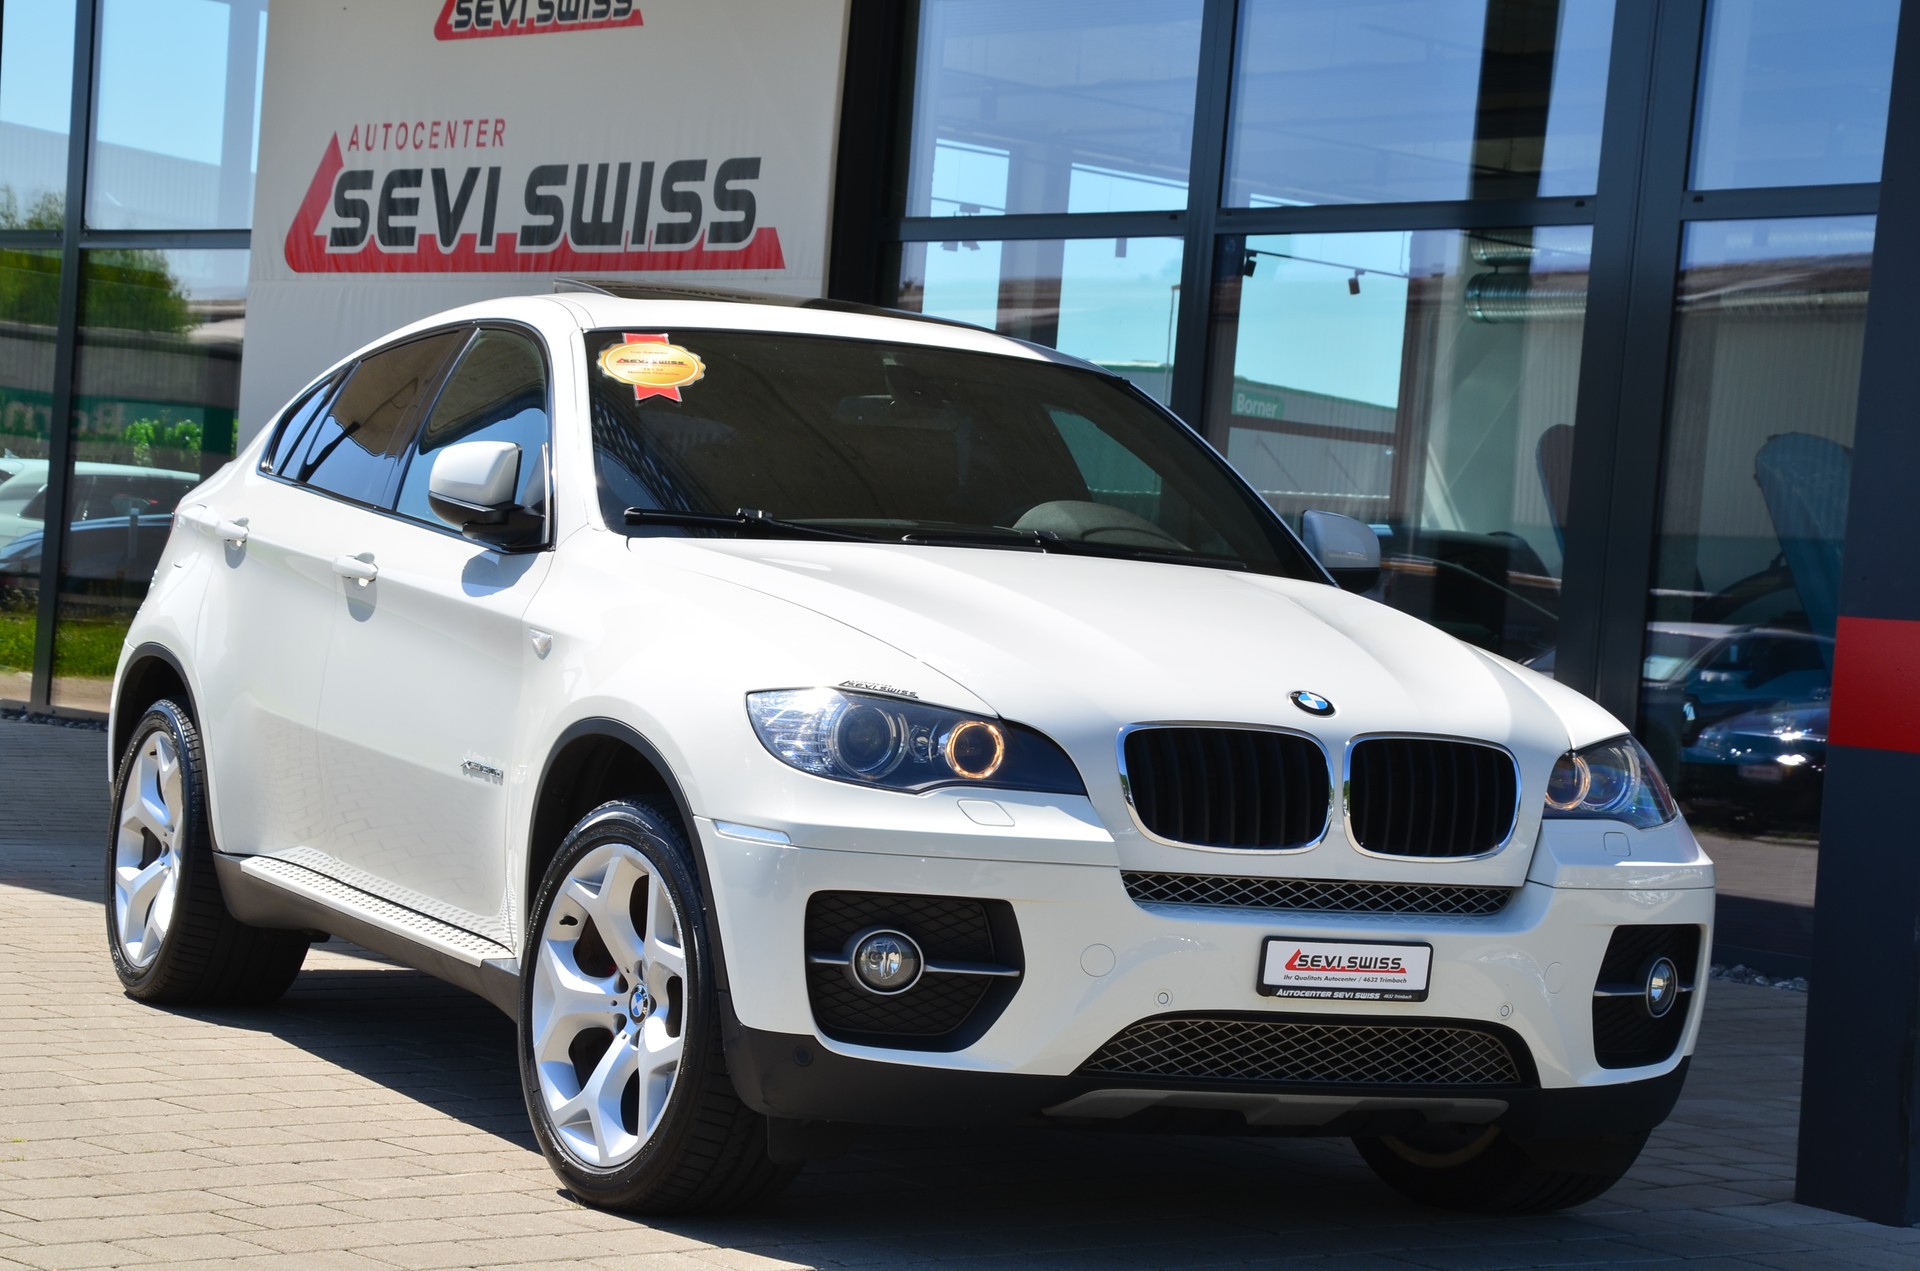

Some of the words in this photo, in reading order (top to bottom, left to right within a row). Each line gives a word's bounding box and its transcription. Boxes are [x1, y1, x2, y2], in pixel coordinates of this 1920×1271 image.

[454, 0, 529, 29] SEVI
[348, 118, 507, 152] AUTOCENTER
[328, 166, 502, 248] SEVI
[518, 157, 762, 247] SWISS
[1236, 393, 1279, 417] Borner
[1297, 955, 1343, 968] SEVI
[1346, 956, 1402, 969] SWISS
[1323, 975, 1357, 983] Autocenter
[1332, 991, 1355, 999] SEVI
[1354, 992, 1381, 1000] SWISS
